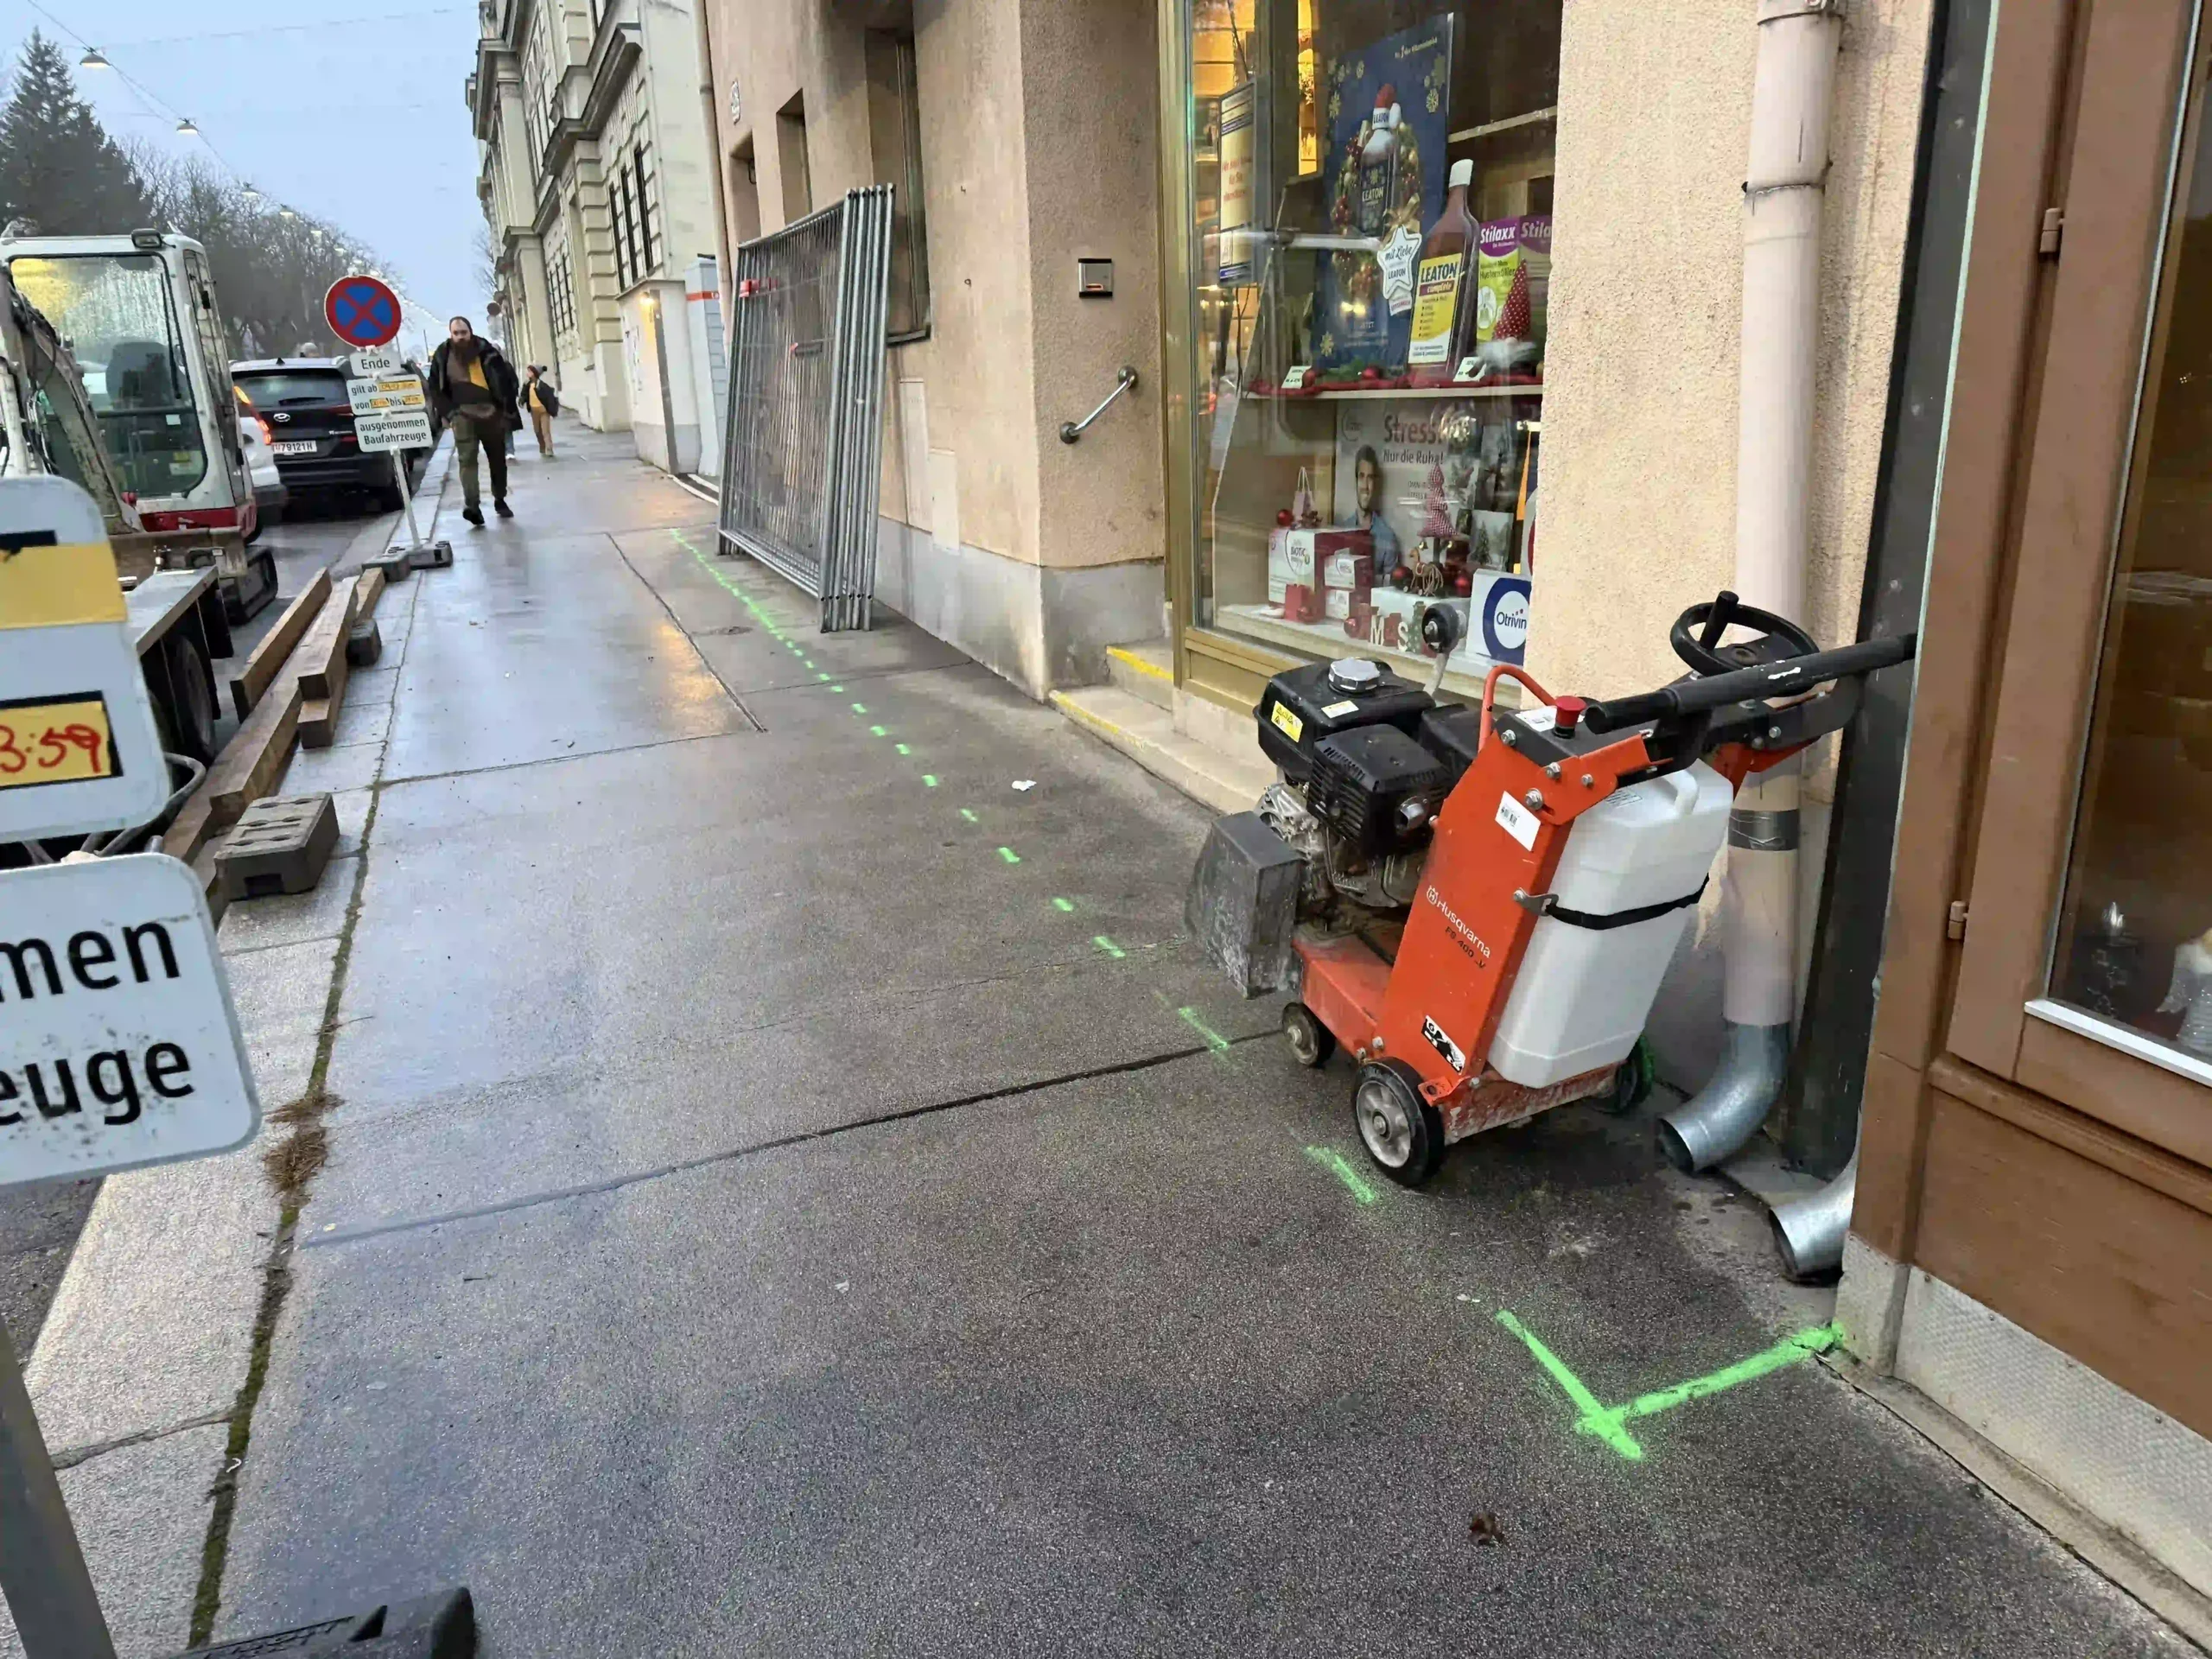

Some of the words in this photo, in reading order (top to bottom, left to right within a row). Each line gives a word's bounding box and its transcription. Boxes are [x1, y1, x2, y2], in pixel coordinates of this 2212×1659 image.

[1362, 186, 1383, 202] LEATON
[1480, 225, 1516, 244] Stilaxx
[1385, 248, 1396, 261] mit
[1395, 244, 1413, 260] Liebe
[1388, 268, 1407, 280] LEATON
[1421, 263, 1458, 283] LEATON
[360, 358, 391, 370] Ende
[351, 385, 365, 397] gilt
[367, 384, 378, 393] ab
[354, 400, 370, 410] von
[389, 397, 402, 406] bis
[359, 418, 426, 432] ausgenommen
[364, 431, 427, 445] Baufahrzeuge
[1383, 449, 1399, 462] Nur
[1401, 448, 1414, 463] die
[1496, 611, 1527, 629] Otrivin
[1436, 901, 1491, 958] Husqvarna
[1457, 939, 1474, 958] 400
